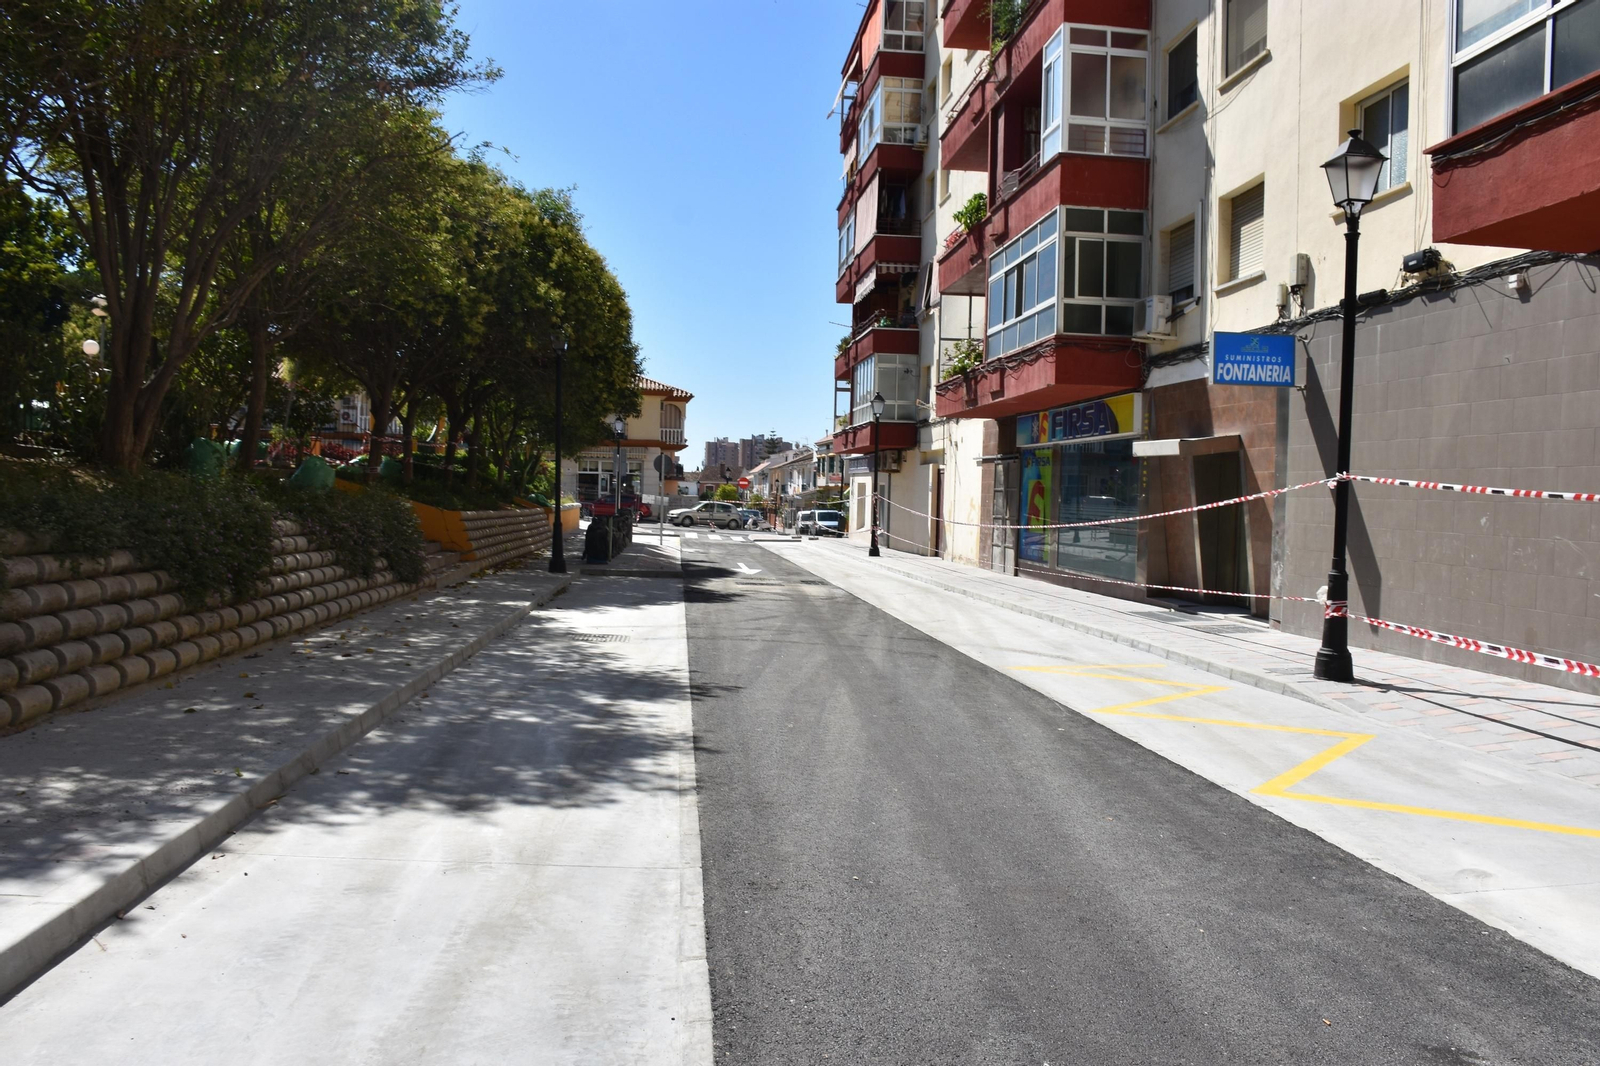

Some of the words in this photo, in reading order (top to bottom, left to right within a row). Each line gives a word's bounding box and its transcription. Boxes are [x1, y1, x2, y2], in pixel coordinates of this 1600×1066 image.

[1225, 354, 1282, 363] SUMINISTROS
[1217, 363, 1291, 383] FONTANERIA
[1051, 400, 1112, 441] FIRSA
